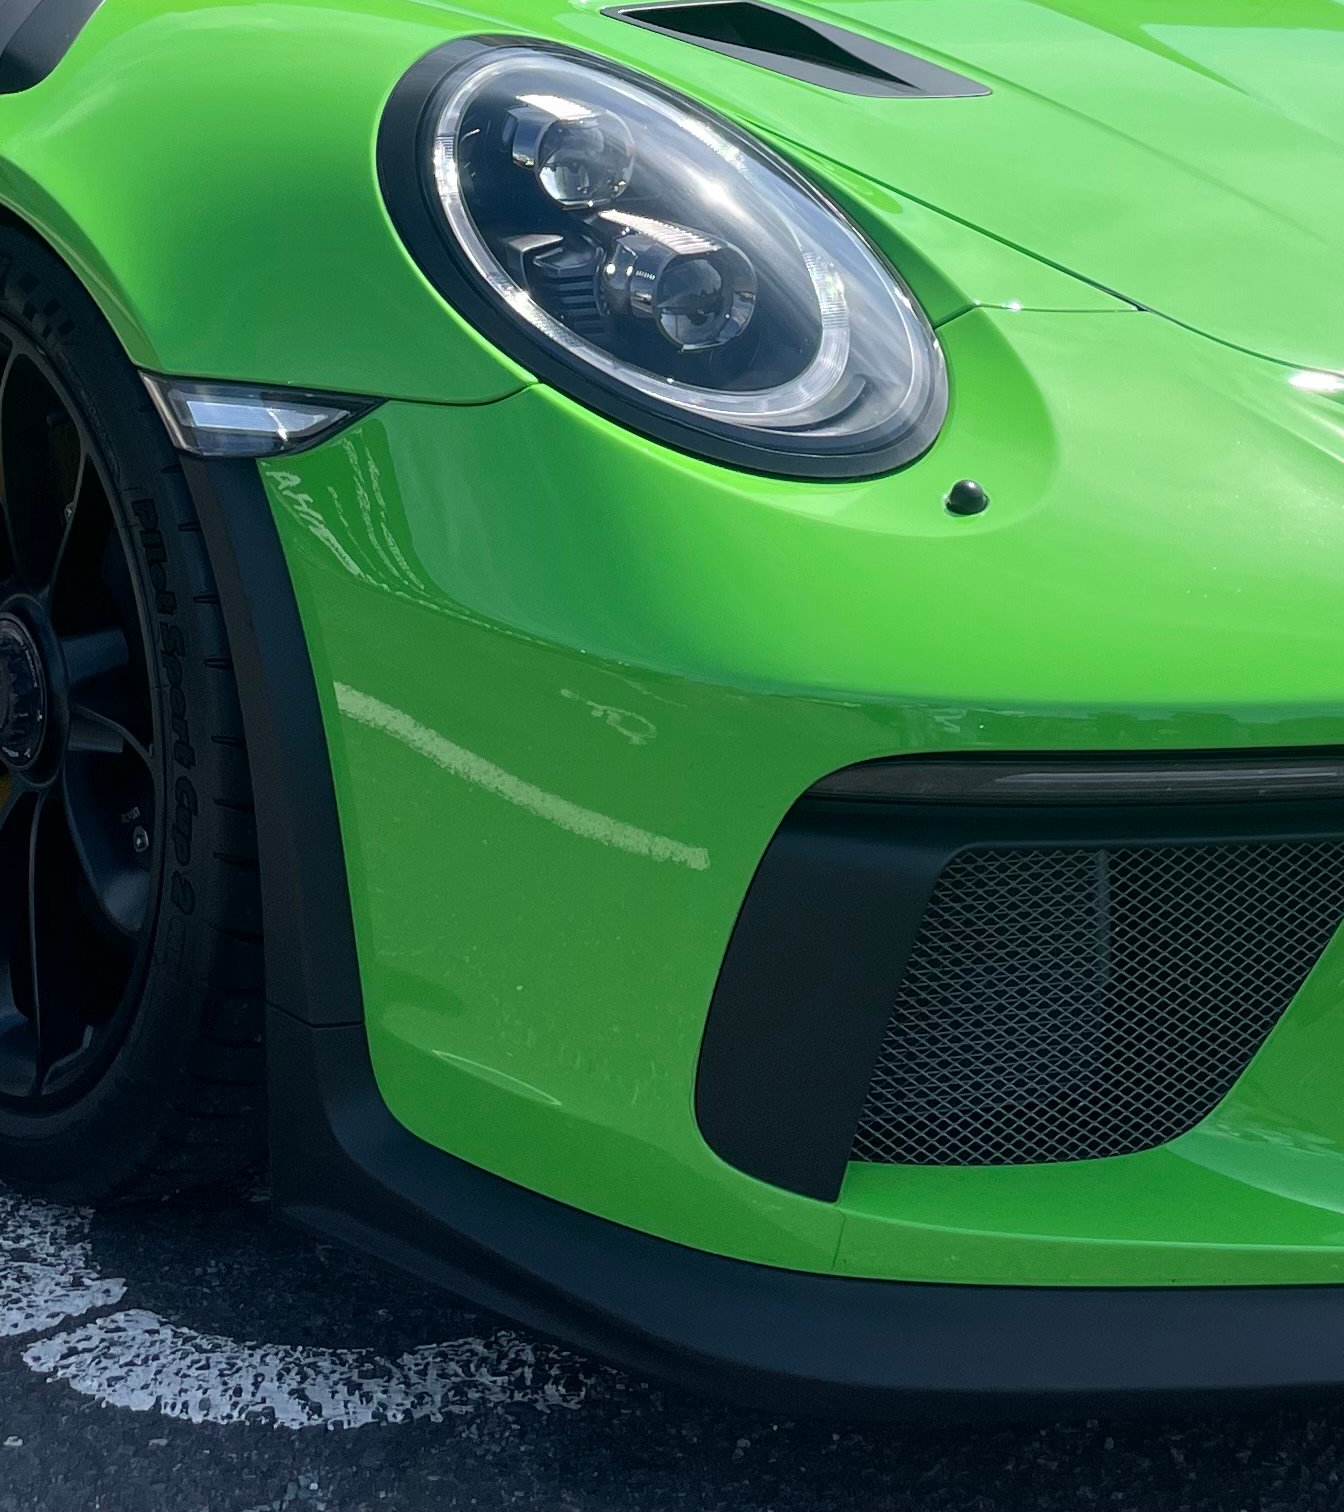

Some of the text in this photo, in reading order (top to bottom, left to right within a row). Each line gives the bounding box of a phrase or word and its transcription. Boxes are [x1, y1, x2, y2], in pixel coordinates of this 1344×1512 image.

[131, 498, 199, 916] Pilot Sport Cup 2
